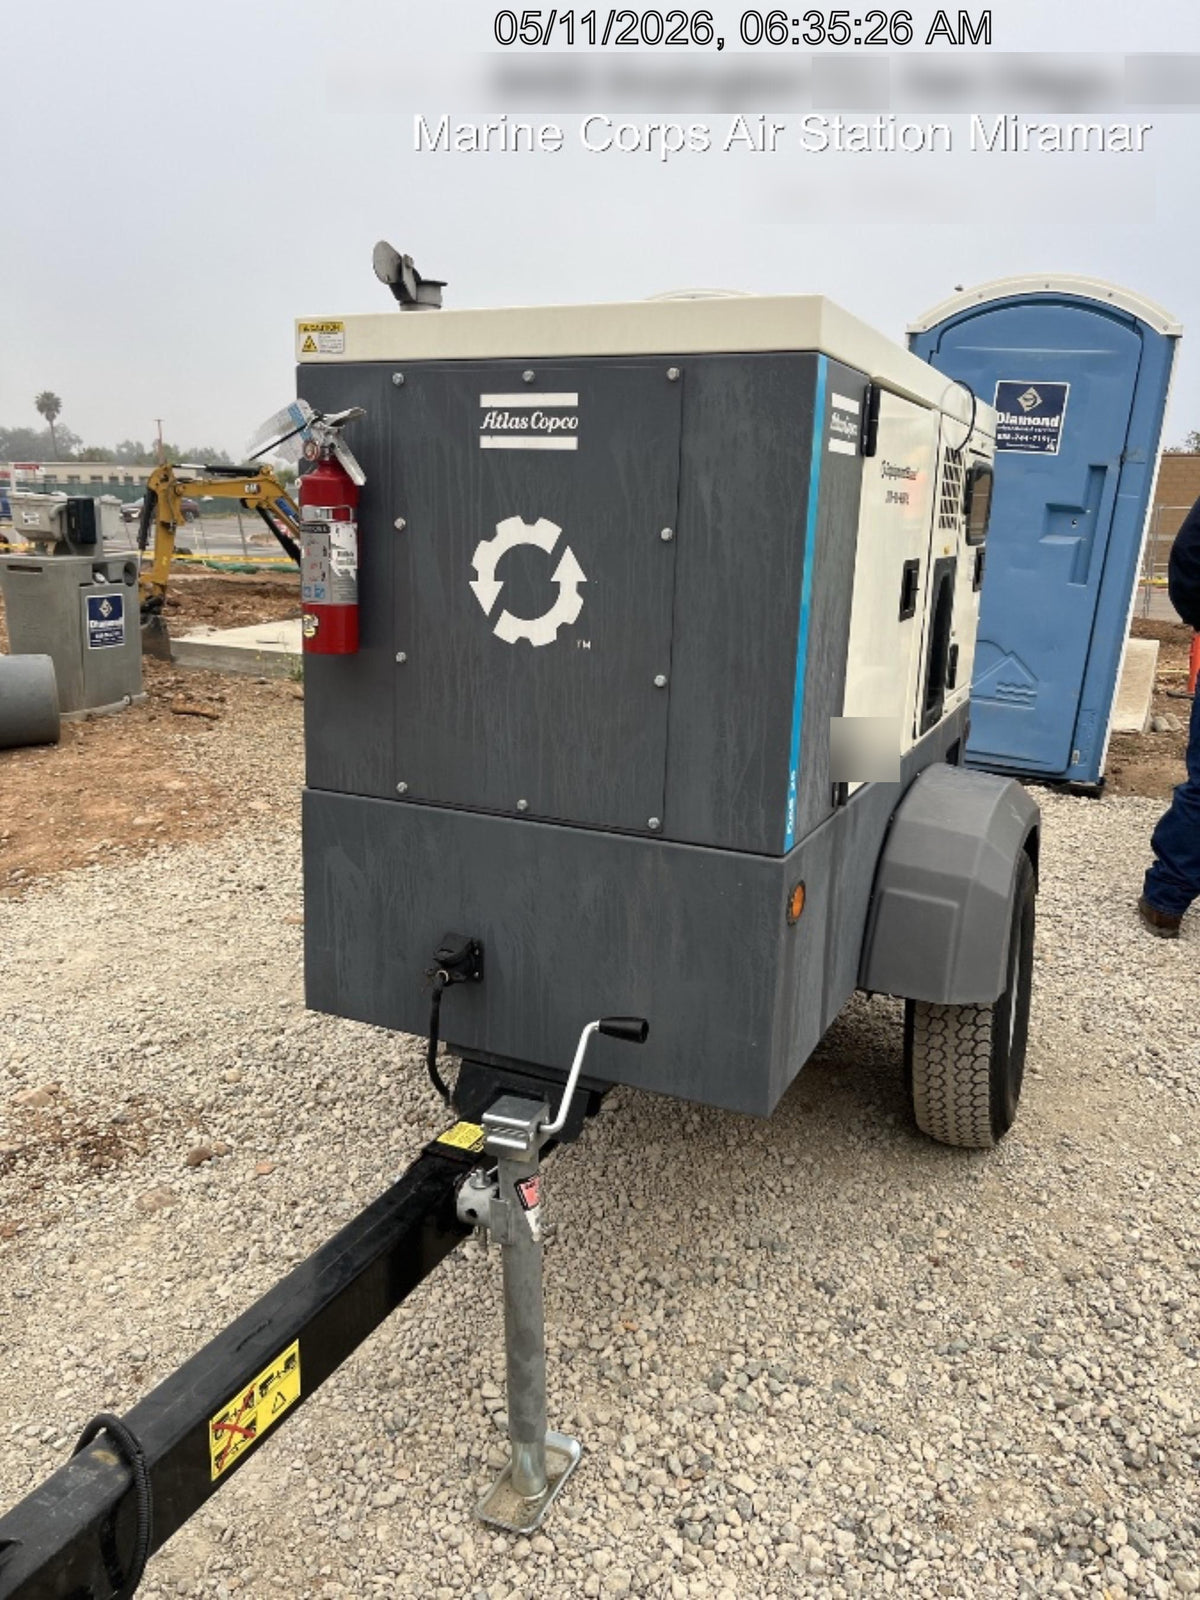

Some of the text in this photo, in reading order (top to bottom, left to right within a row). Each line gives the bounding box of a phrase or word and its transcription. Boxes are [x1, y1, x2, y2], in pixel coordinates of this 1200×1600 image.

[480, 410, 579, 433] Atlas Copco
[996, 411, 1060, 428] Diamond
